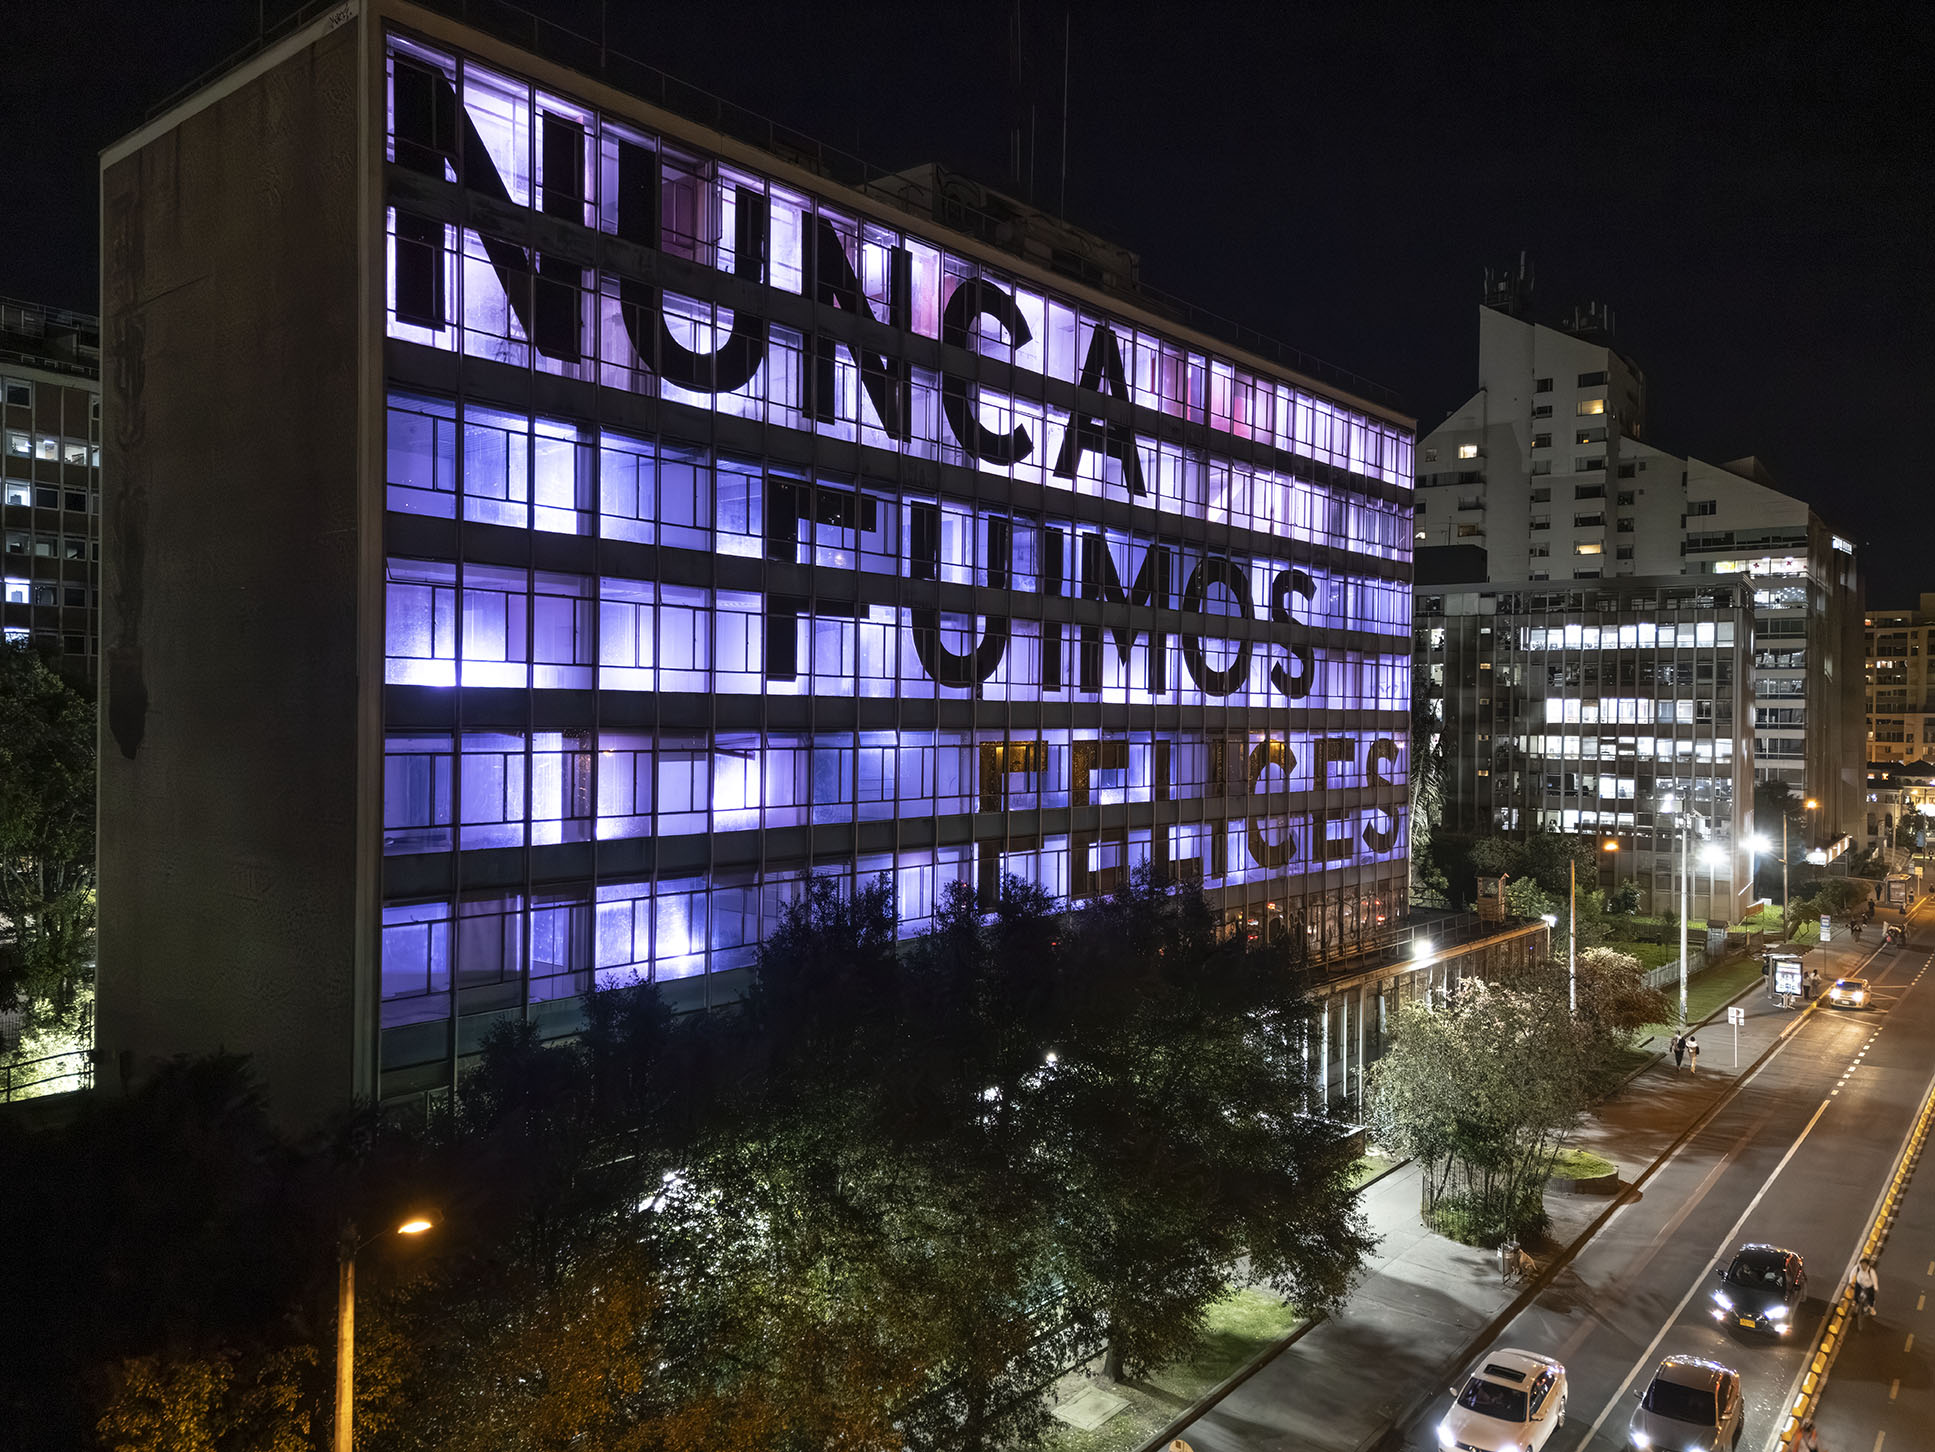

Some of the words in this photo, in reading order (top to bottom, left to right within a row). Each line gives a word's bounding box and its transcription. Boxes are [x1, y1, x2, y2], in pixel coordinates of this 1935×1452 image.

[394, 51, 1146, 498] NUNCA
[767, 478, 1317, 699] FUIMOS
[979, 738, 1399, 910] FELICES
